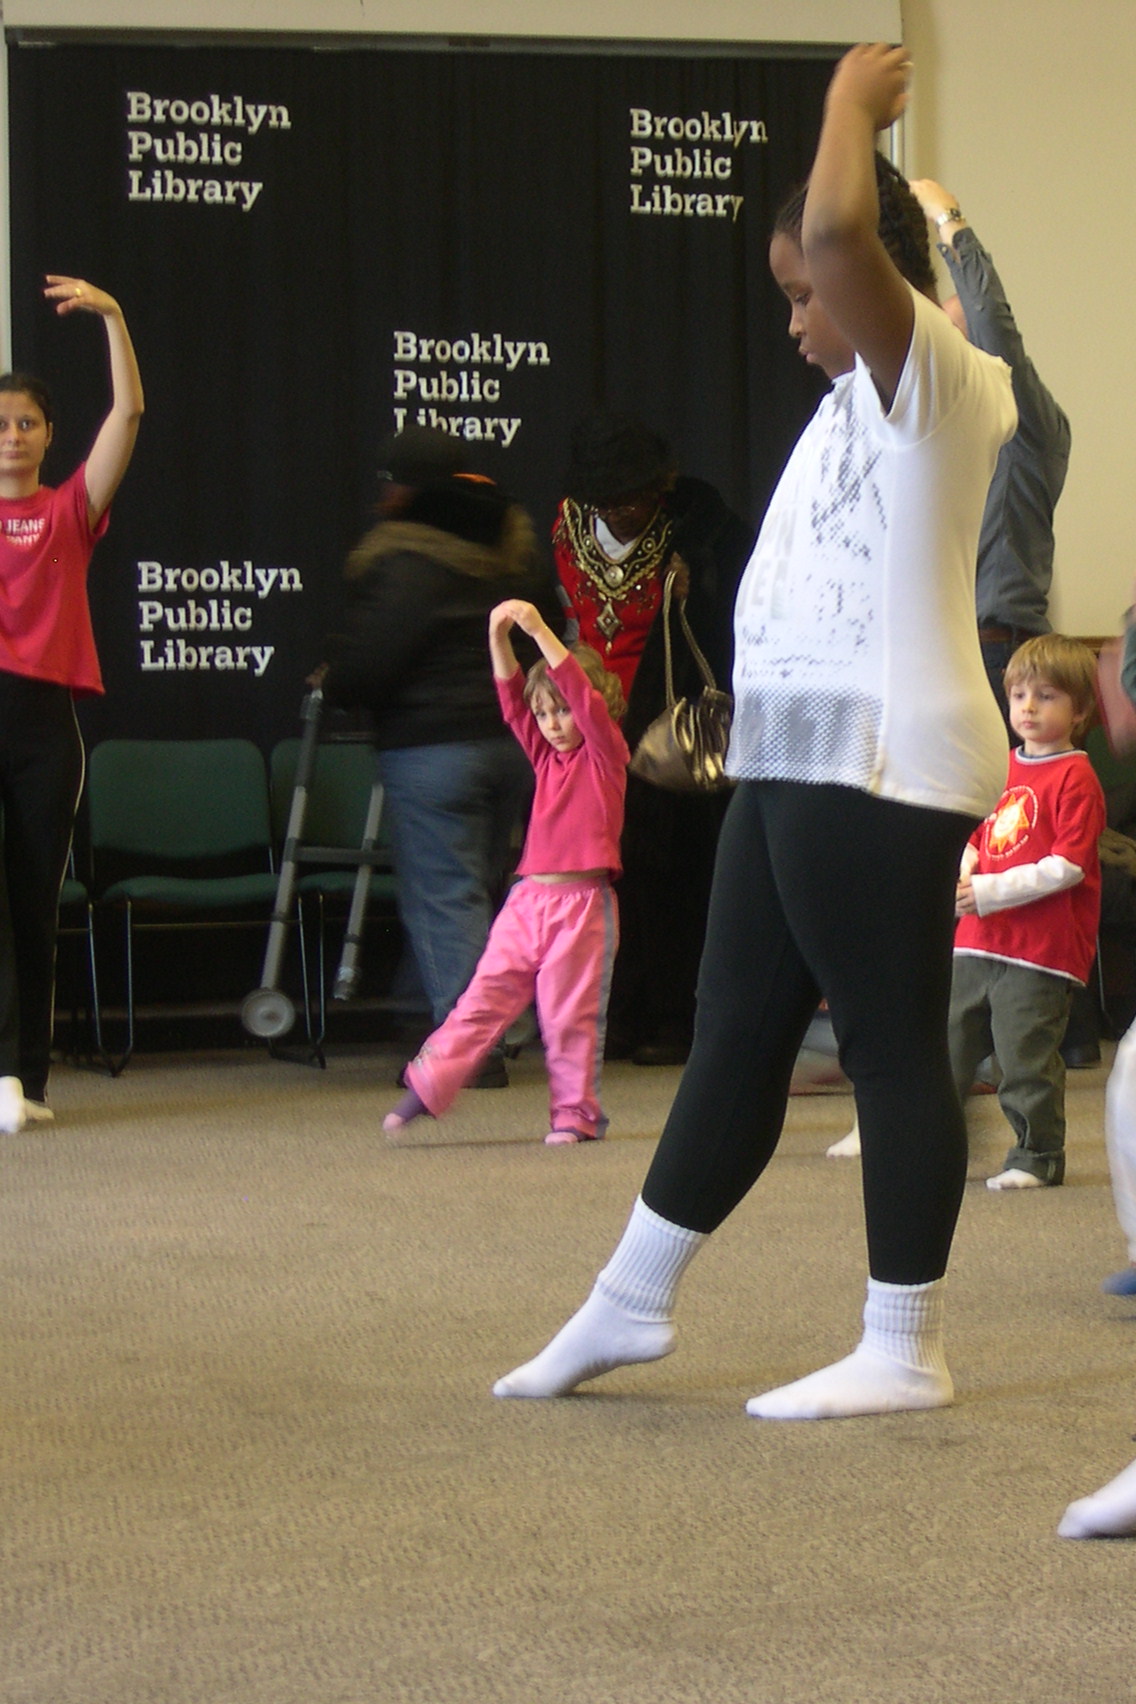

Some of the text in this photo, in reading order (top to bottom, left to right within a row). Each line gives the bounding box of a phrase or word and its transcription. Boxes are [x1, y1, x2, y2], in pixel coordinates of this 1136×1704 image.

[126, 91, 292, 135] Brooklyn
[629, 107, 769, 148] Brooklyn
[127, 130, 243, 166] Public
[630, 145, 732, 180] Public
[127, 169, 264, 212] Library
[629, 183, 744, 223] Library
[393, 330, 551, 372] Brooklyn
[393, 368, 501, 403] Public
[137, 560, 304, 599] Brooklyn
[138, 598, 253, 632] Public
[139, 638, 275, 677] Library
